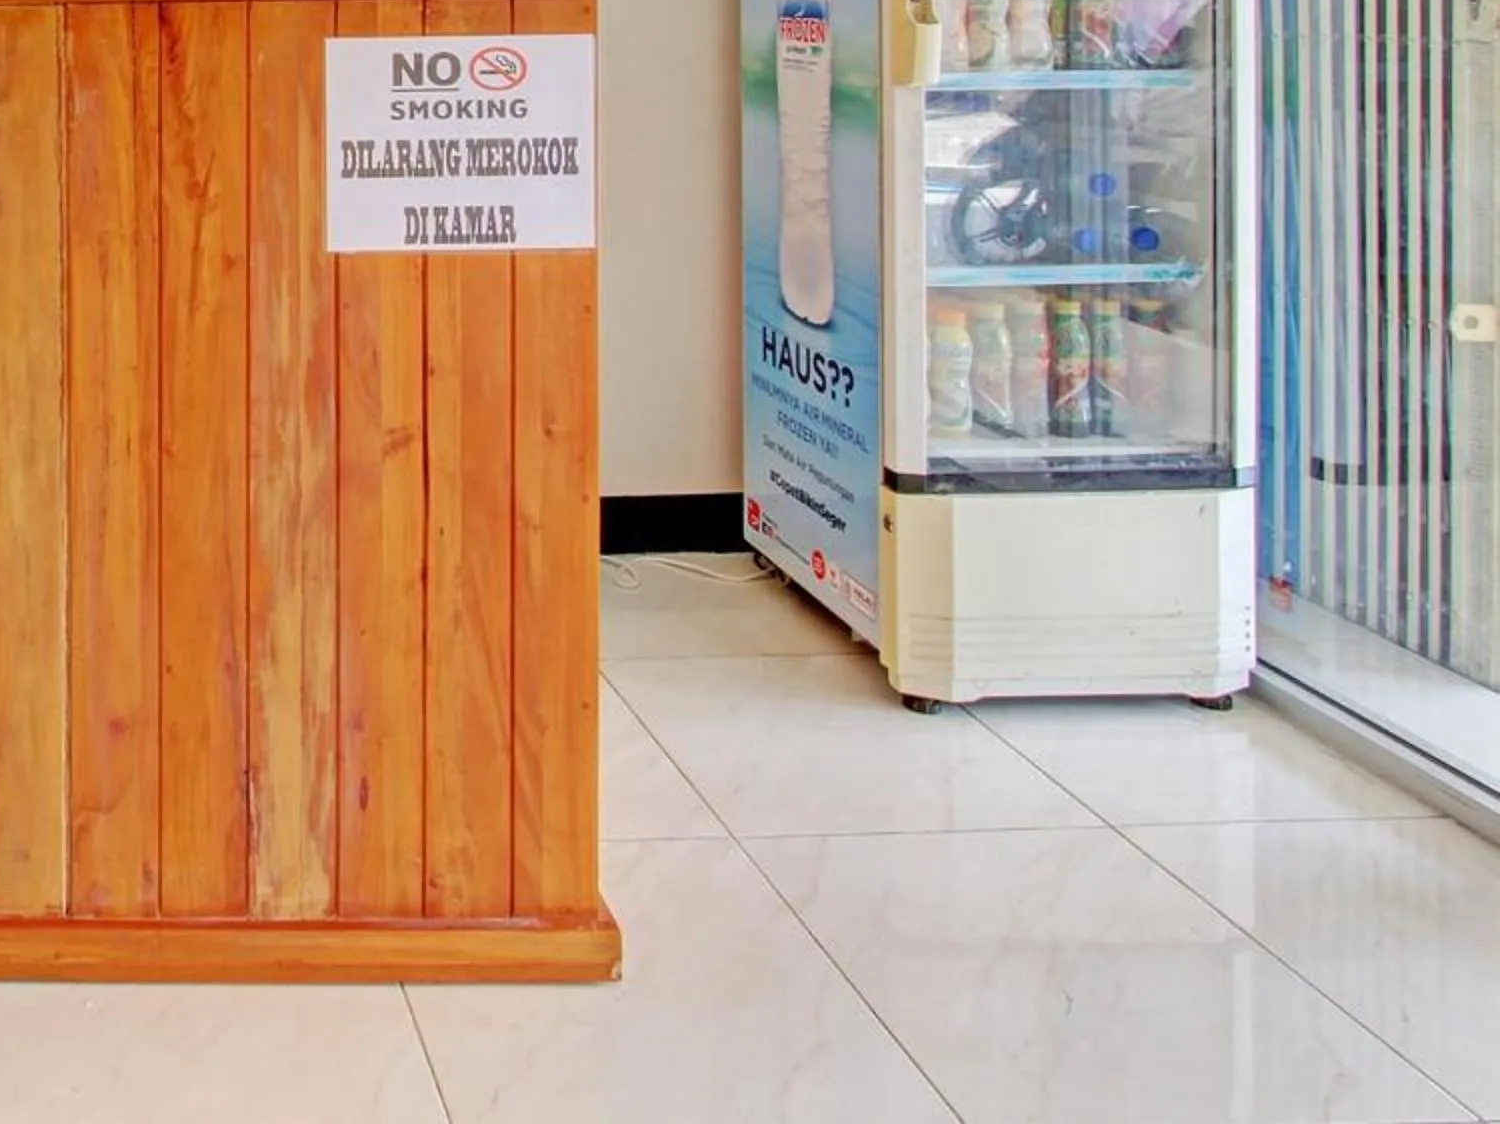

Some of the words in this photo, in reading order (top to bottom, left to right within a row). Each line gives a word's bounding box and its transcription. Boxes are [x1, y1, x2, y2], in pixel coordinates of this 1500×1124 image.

[391, 51, 461, 87] NO
[390, 98, 528, 120] SMOKING
[341, 139, 460, 178] DILARANG
[465, 137, 579, 176] MEROKOK
[404, 206, 429, 244] DI
[433, 205, 516, 244] KAMAR
[761, 326, 855, 408] HAUS??
[777, 410, 817, 445] FROZEN
